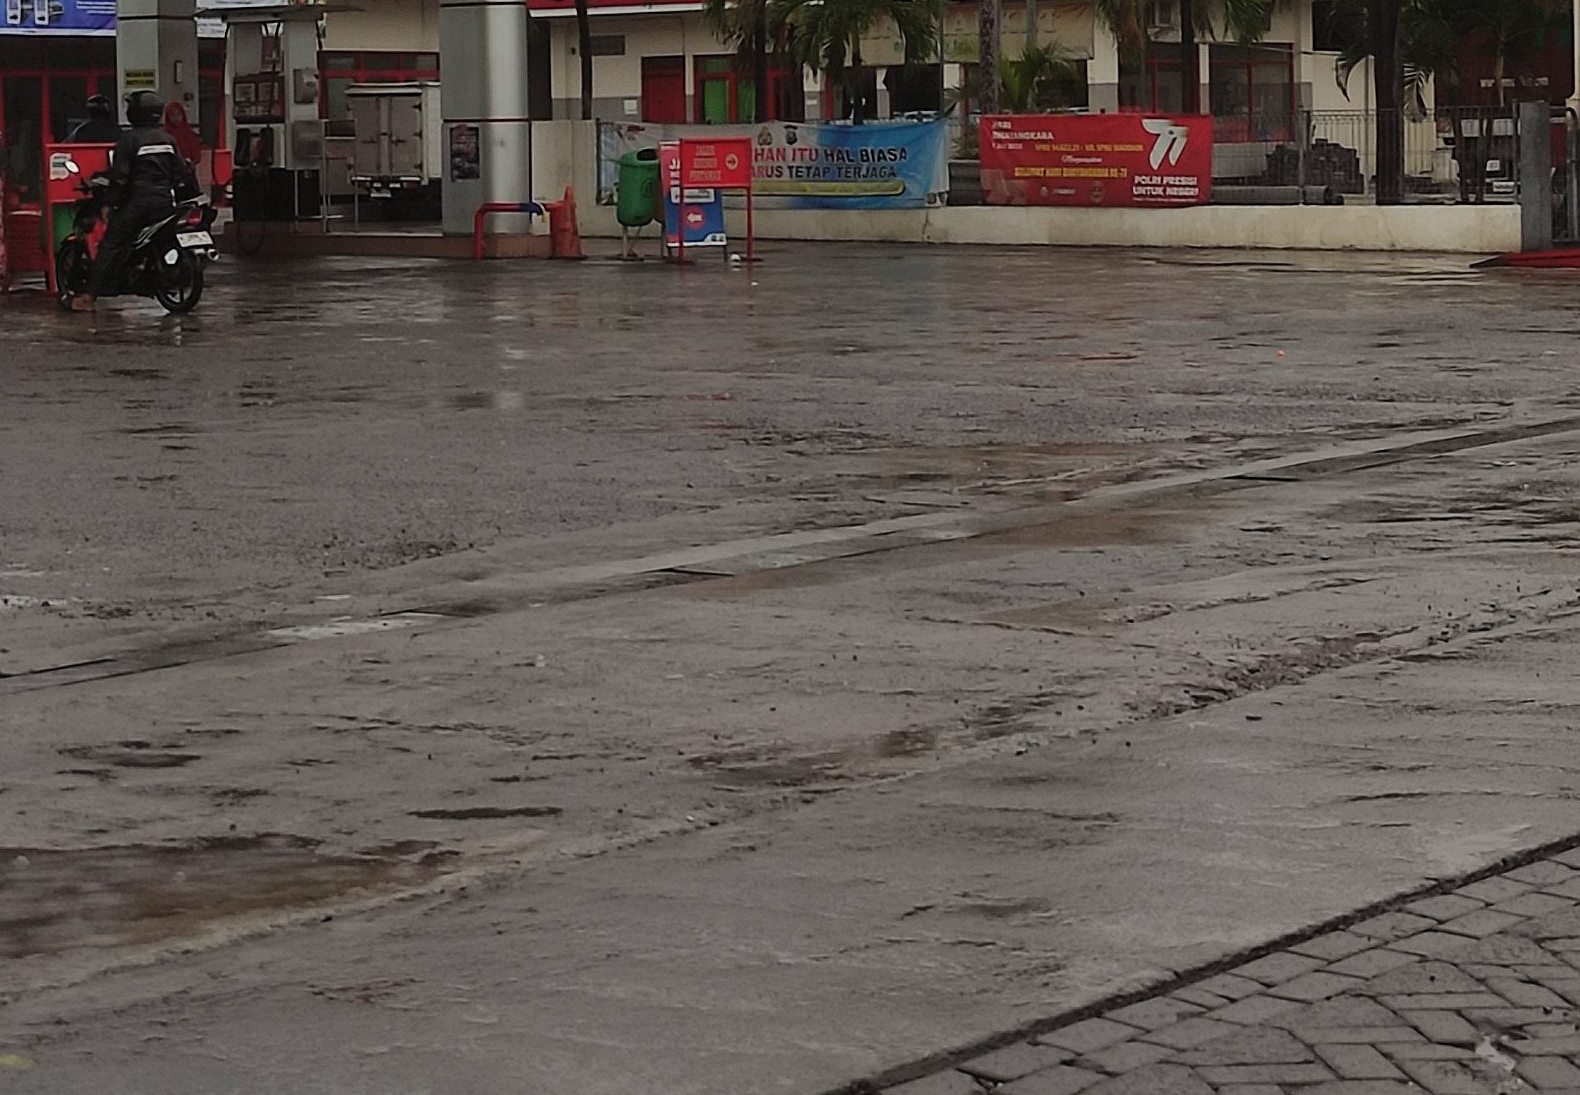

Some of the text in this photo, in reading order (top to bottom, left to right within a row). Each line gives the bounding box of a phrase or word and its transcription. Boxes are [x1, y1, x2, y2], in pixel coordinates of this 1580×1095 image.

[791, 148, 819, 162] ITU
[824, 150, 855, 163] HAL
[859, 148, 908, 163] BIASA
[751, 165, 898, 179] ARUS TETAP TERJAGA
